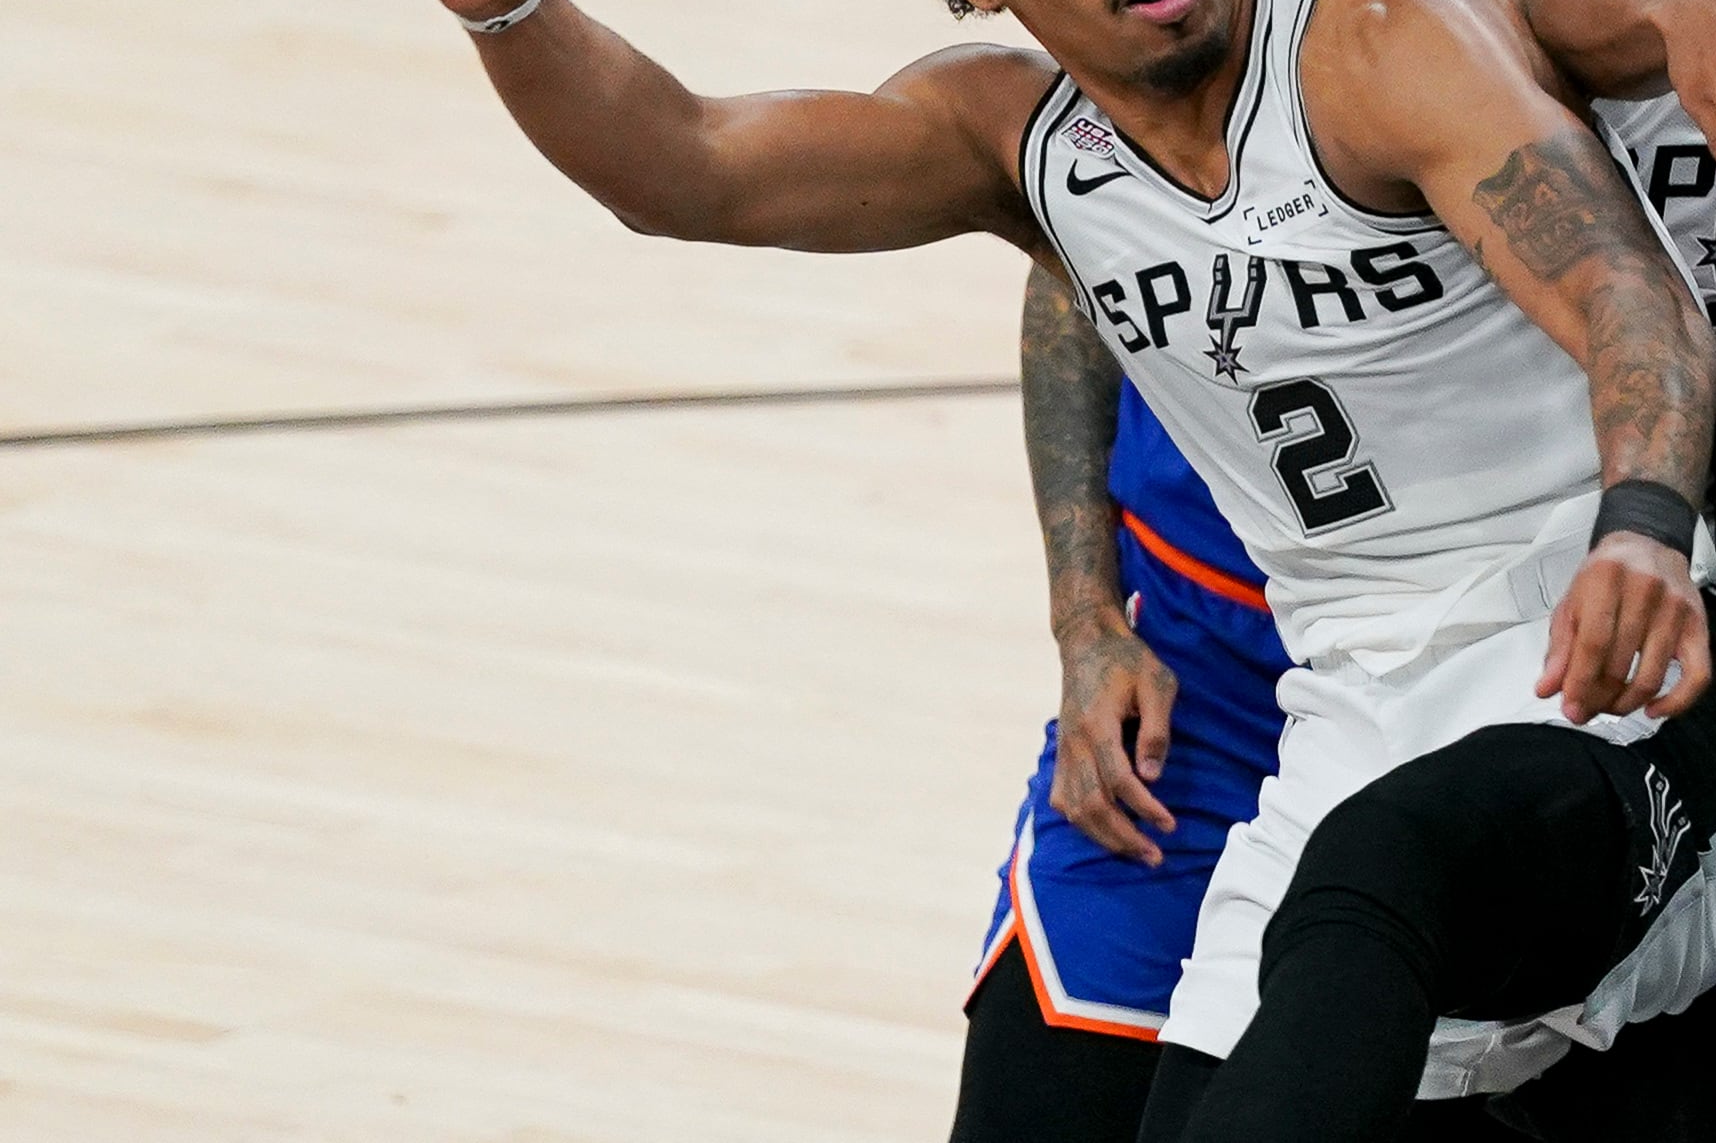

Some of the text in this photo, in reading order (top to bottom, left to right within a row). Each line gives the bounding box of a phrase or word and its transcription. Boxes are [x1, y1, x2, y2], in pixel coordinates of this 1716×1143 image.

[1256, 194, 1315, 232] LEDGER
[1093, 241, 1445, 384] SPURS
[1246, 376, 1396, 538] 2
